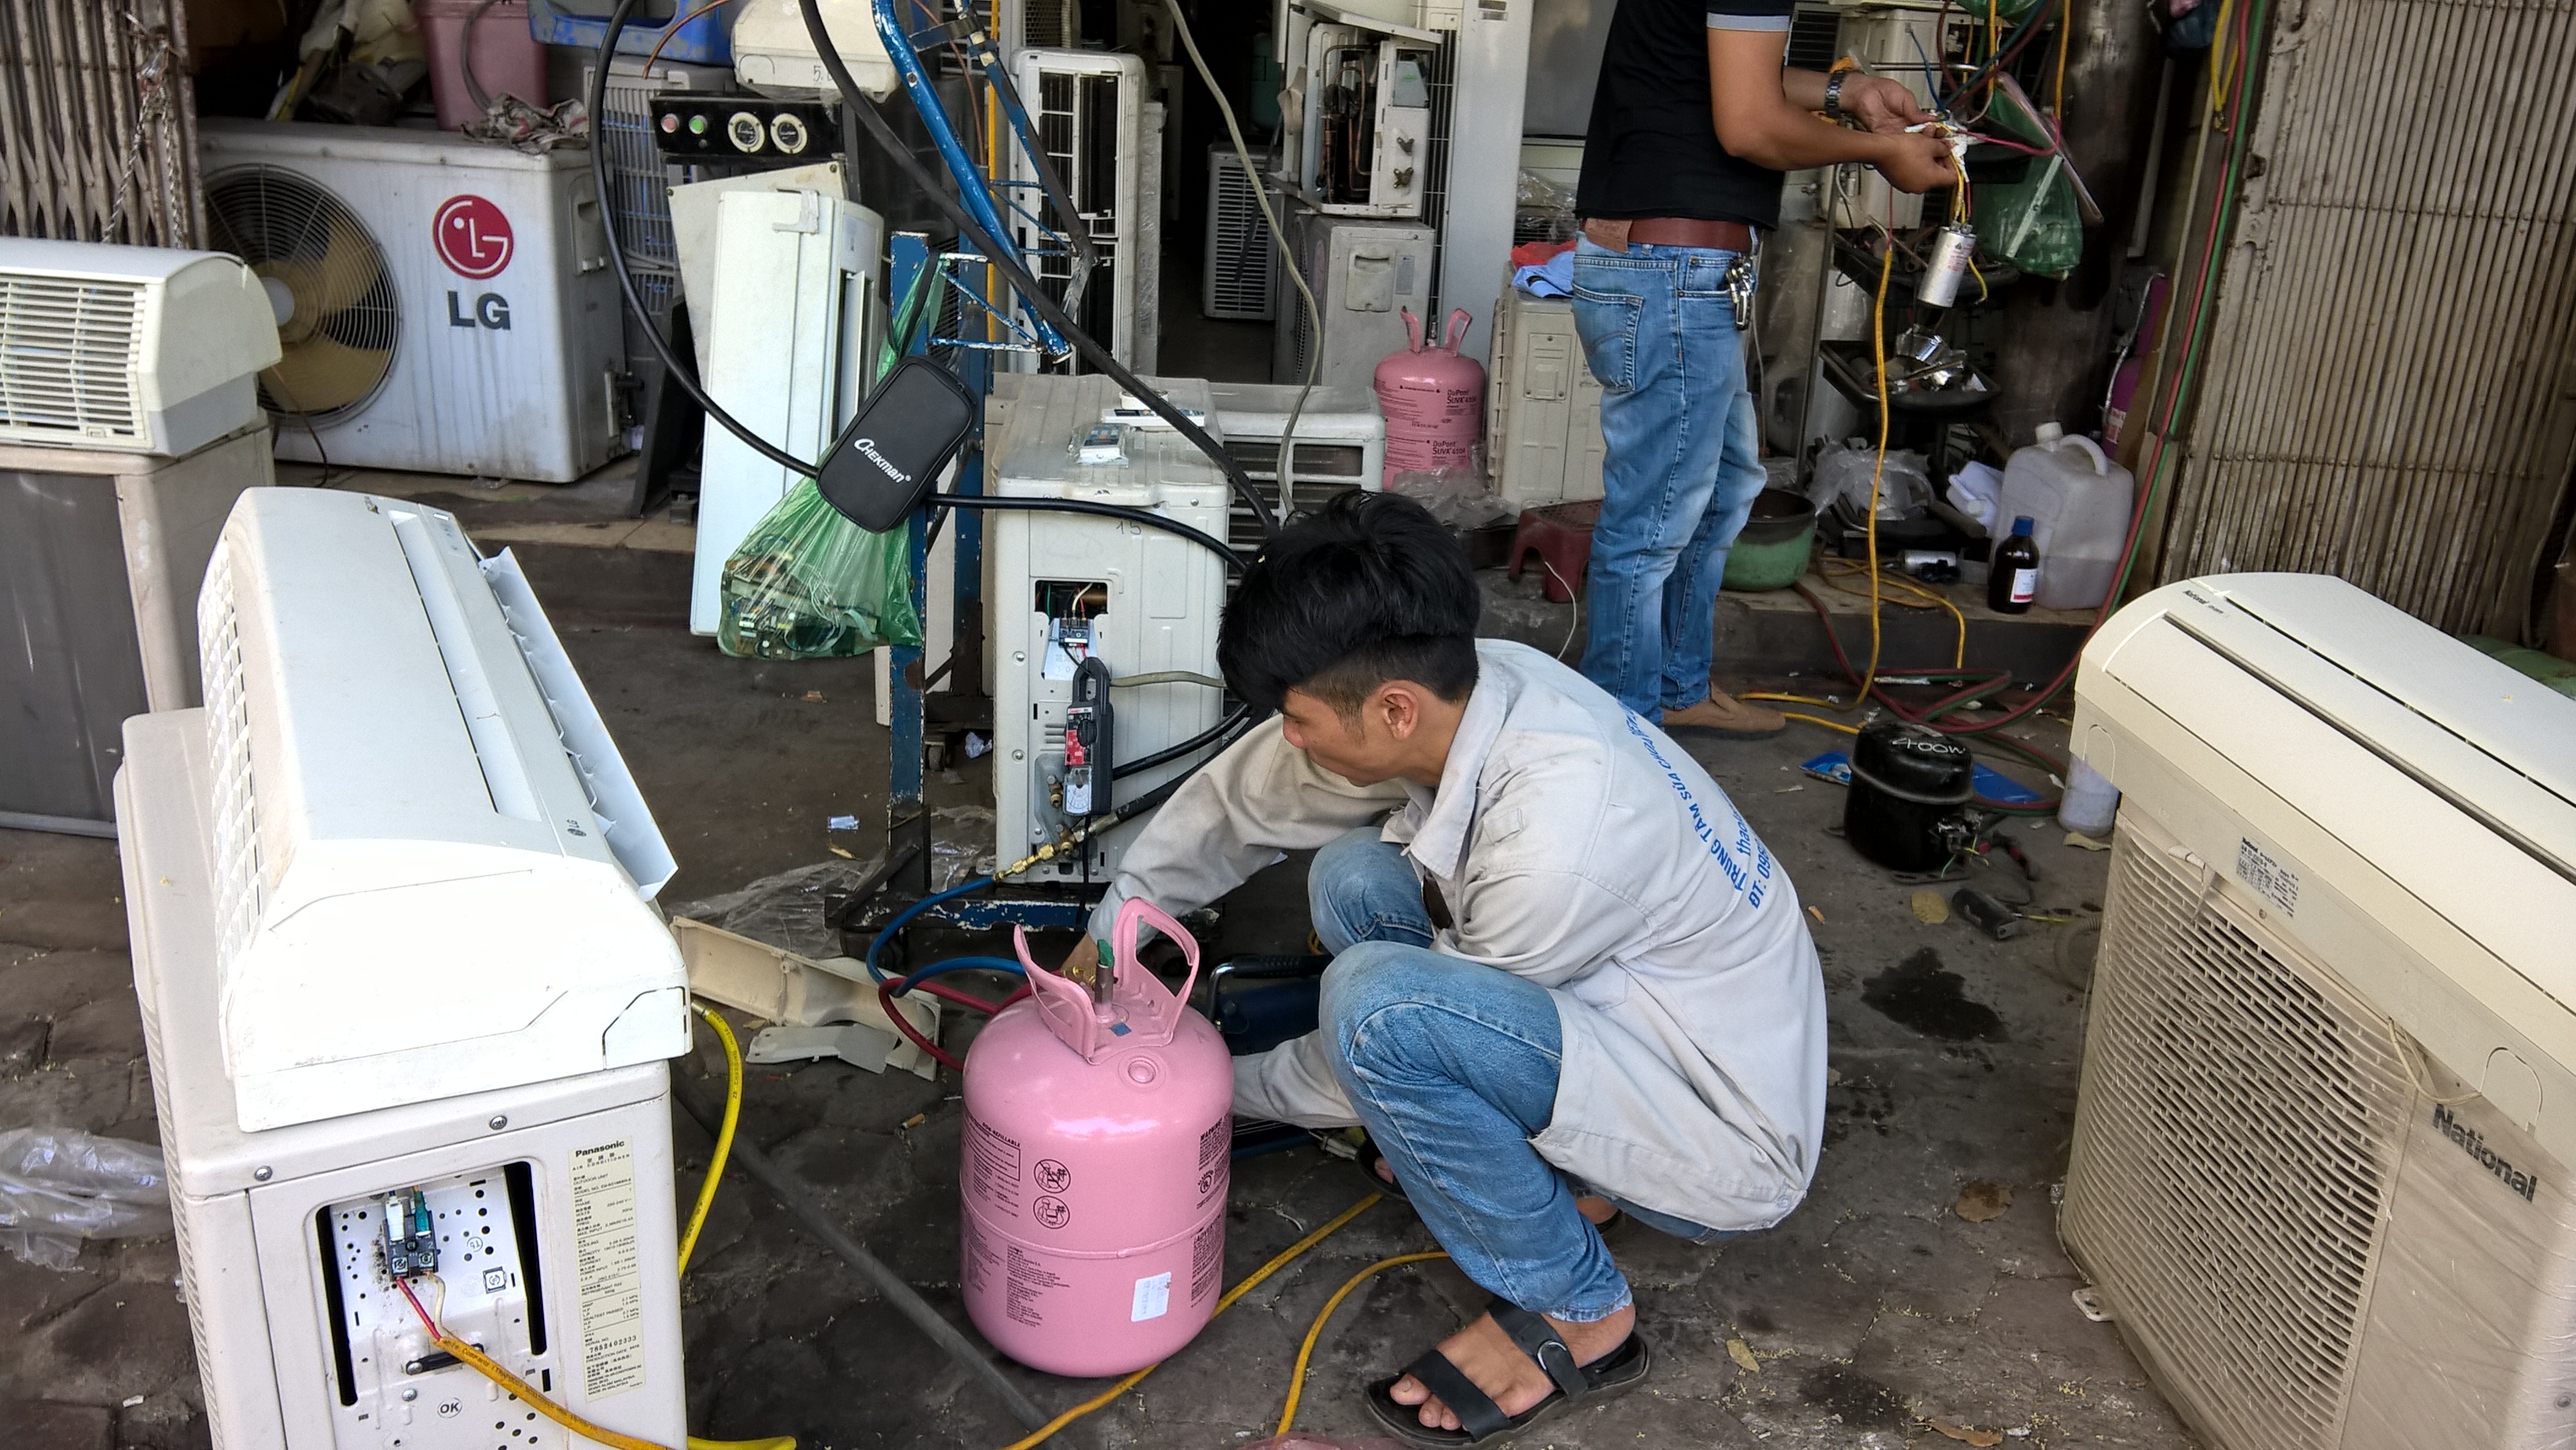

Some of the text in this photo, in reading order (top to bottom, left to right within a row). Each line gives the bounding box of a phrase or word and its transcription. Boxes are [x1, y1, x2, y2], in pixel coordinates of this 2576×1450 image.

[447, 290, 511, 330] LG
[1710, 838, 1747, 892] TRUNG
[575, 1140, 625, 1158] Panasonic
[2432, 1102, 2537, 1203] National
[440, 1403, 460, 1414] OK
